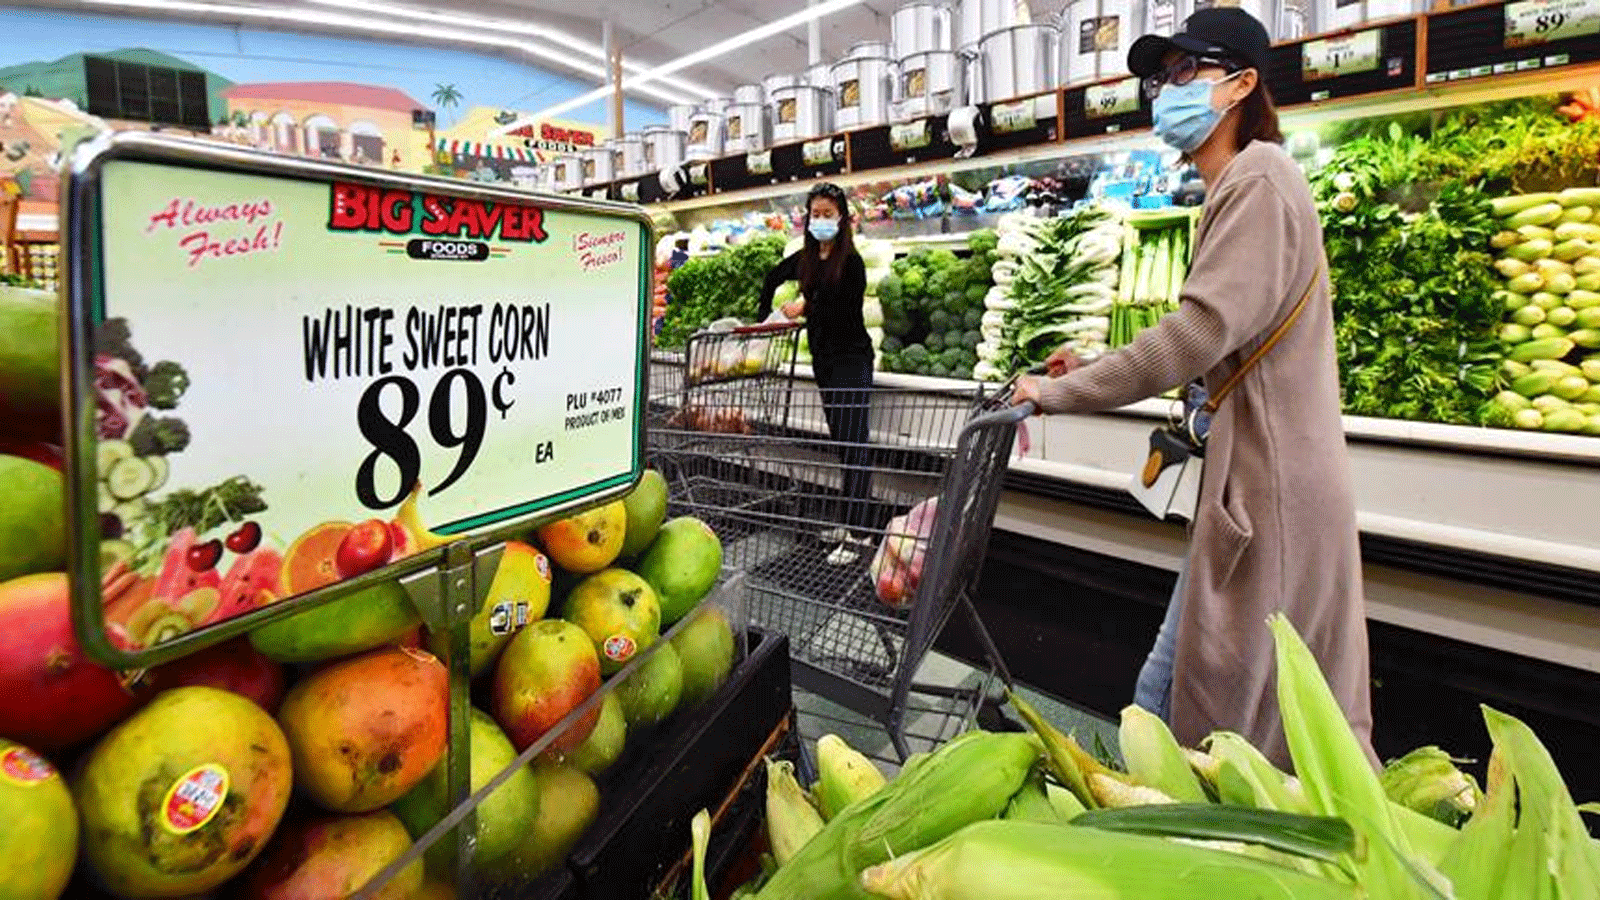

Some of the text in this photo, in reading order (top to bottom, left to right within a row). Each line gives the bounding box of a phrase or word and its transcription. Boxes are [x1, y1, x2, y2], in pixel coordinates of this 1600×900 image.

[146, 199, 271, 232] Always
[329, 181, 549, 243] BIG SAVER
[180, 221, 283, 267] Fresh!
[421, 240, 478, 256] FOODS
[303, 302, 550, 382] WHITE SWEET CORN
[566, 386, 623, 411] PLU #4077
[564, 410, 600, 431] PRODUCT
[535, 440, 554, 464] EA
